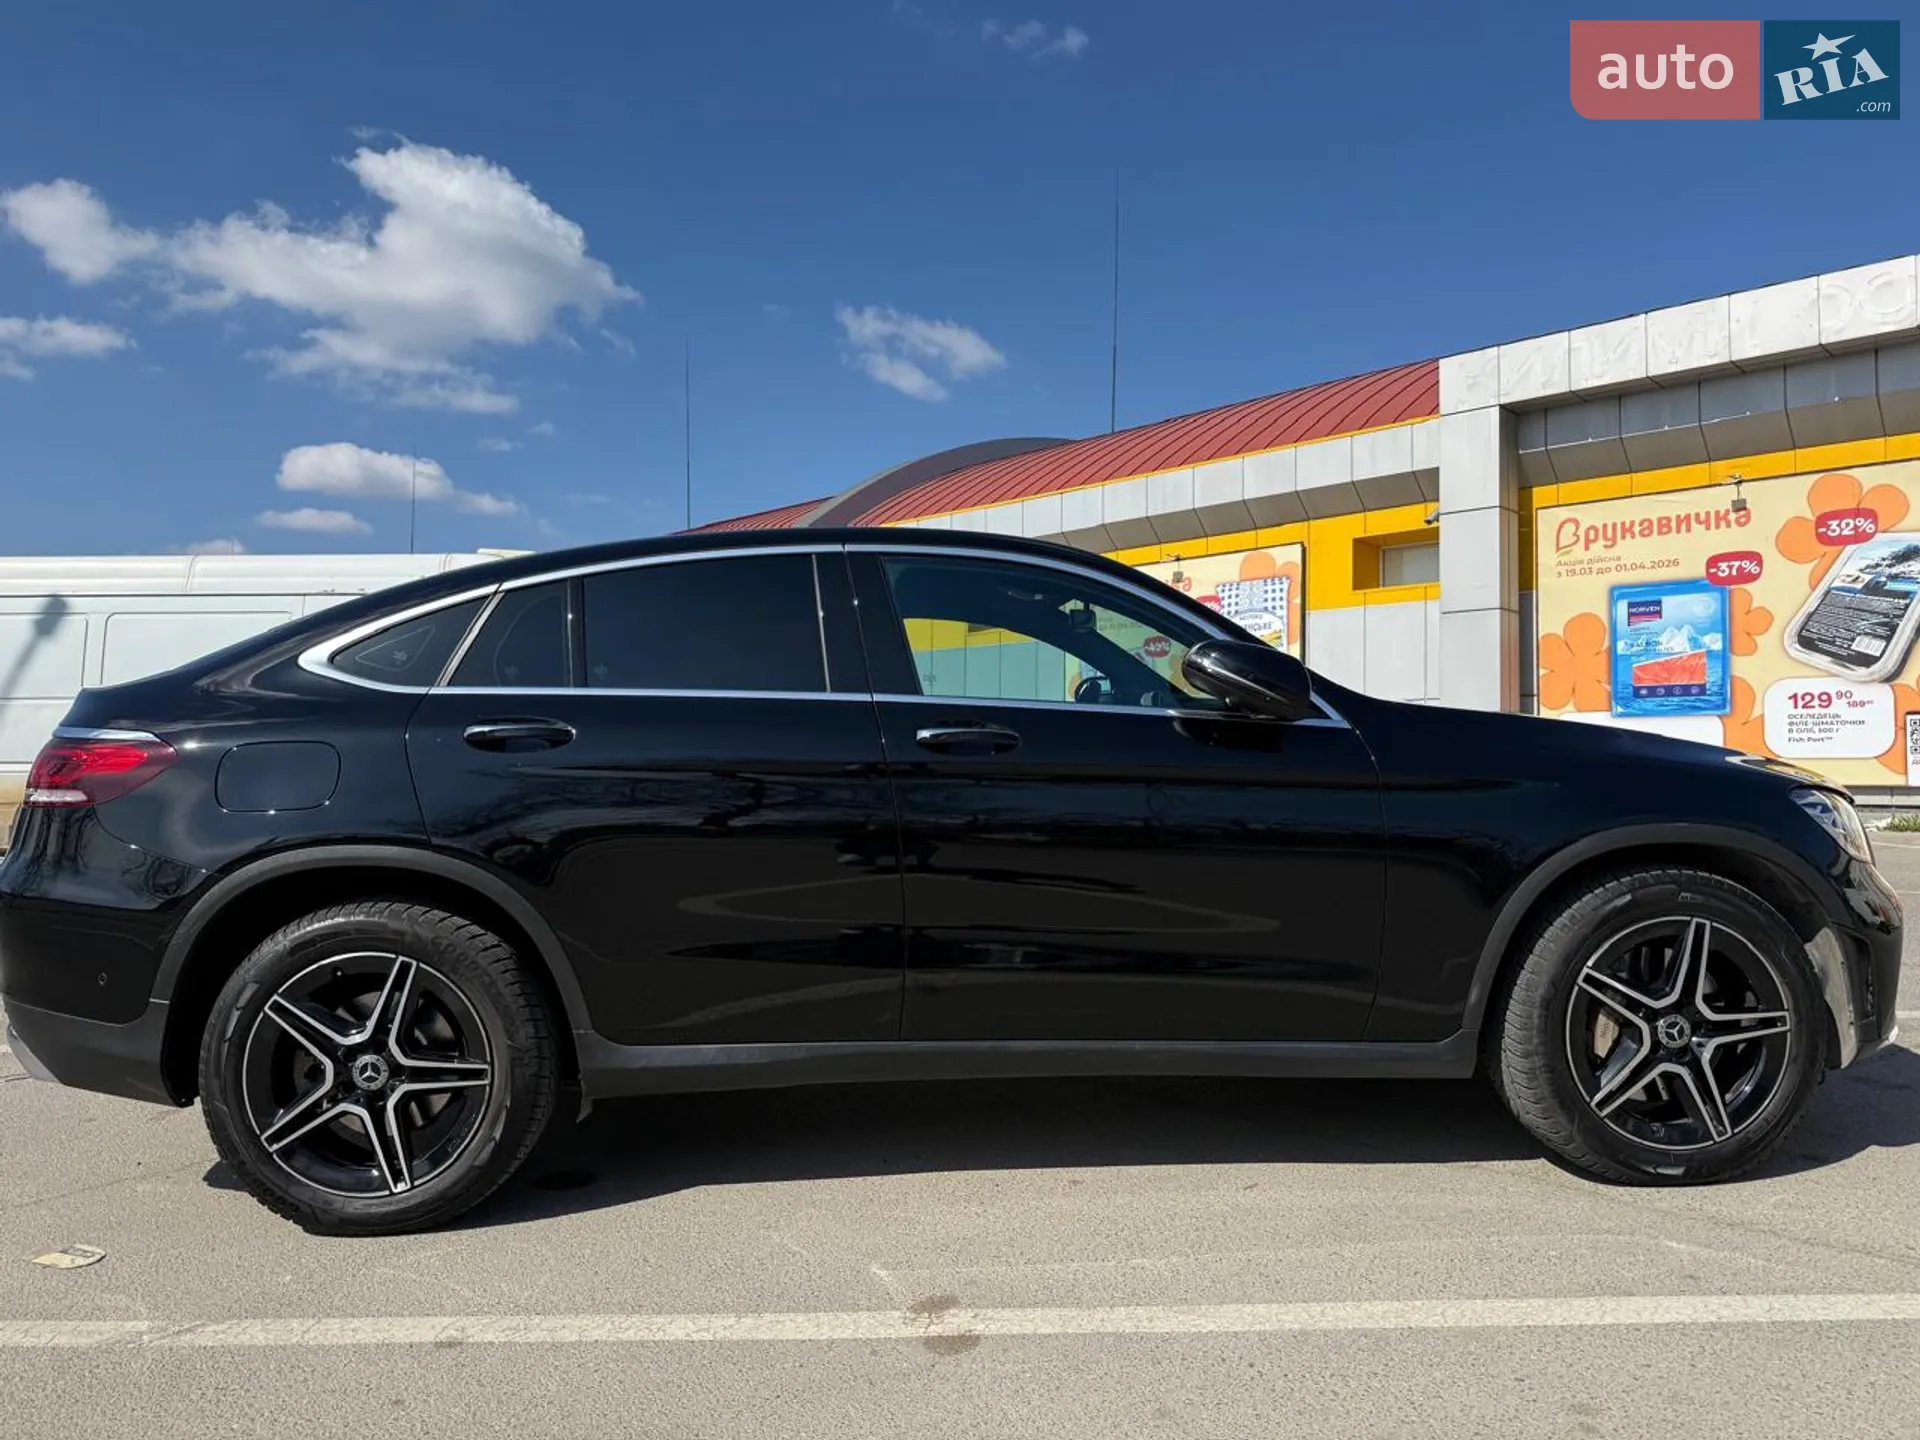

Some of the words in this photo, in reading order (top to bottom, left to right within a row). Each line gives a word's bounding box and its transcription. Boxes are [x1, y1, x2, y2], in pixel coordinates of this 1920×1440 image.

[1817, 517, 1876, 537] -32%
[1565, 566, 1594, 578] 19.03
[1595, 566, 1612, 576] до
[1615, 557, 1680, 573] 01.04.2026
[1708, 559, 1760, 577] -37%
[1788, 691, 1832, 709] 129
[1835, 690, 1854, 700] 90
